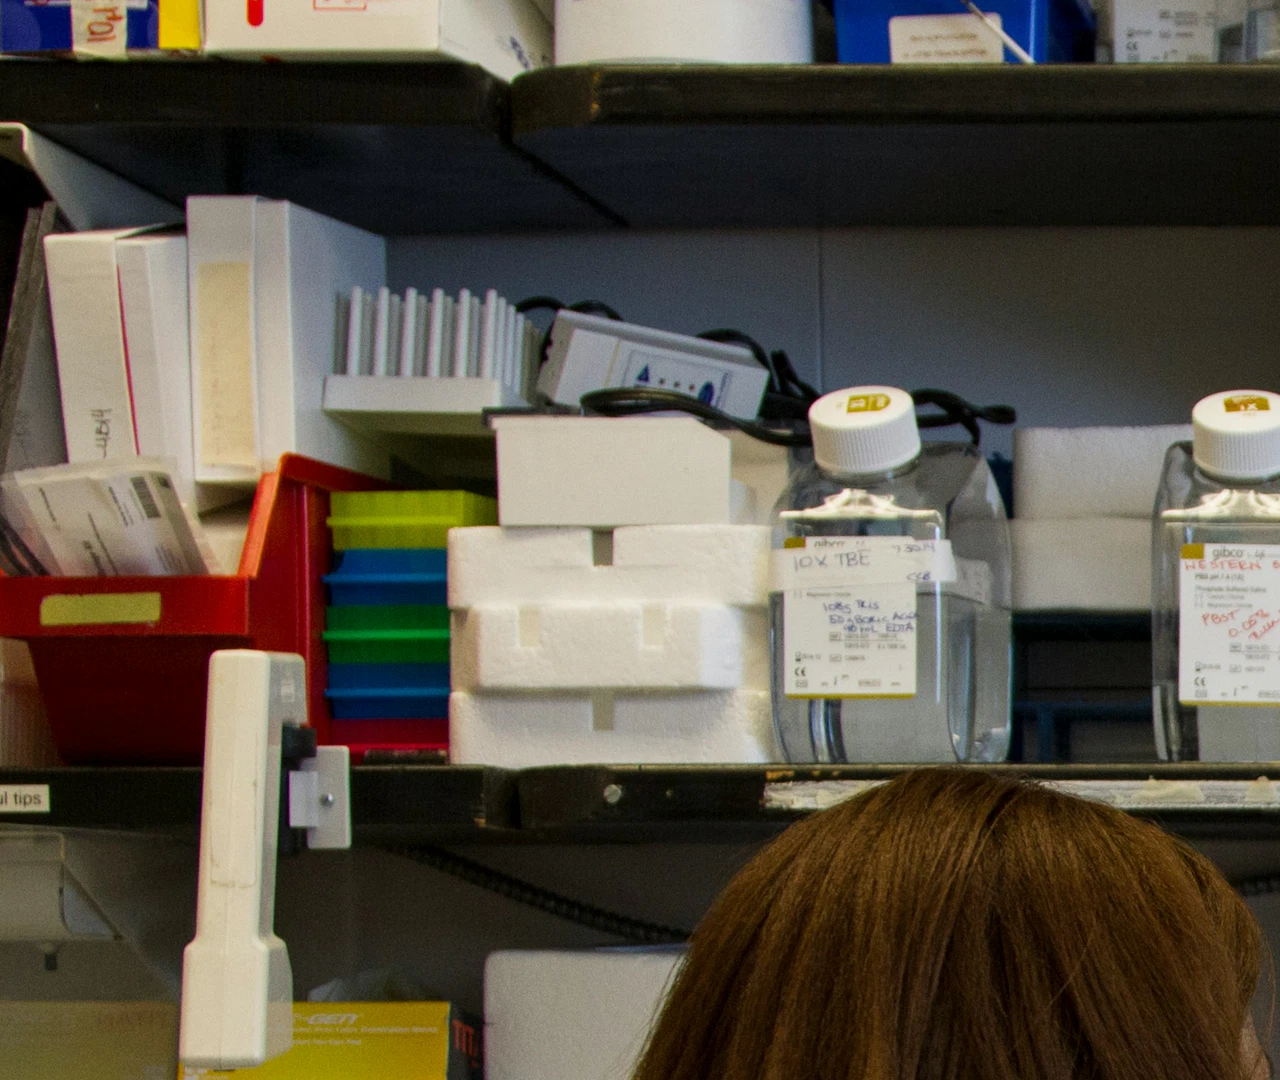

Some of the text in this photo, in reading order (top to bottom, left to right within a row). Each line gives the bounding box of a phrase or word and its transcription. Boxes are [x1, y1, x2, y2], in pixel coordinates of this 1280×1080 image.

[794, 549, 870, 572] 10X TBE
[1213, 546, 1243, 560] gibco
[1185, 560, 1262, 571] WESTERN
[1202, 609, 1240, 625] PBST
[13, 789, 42, 809] tips
